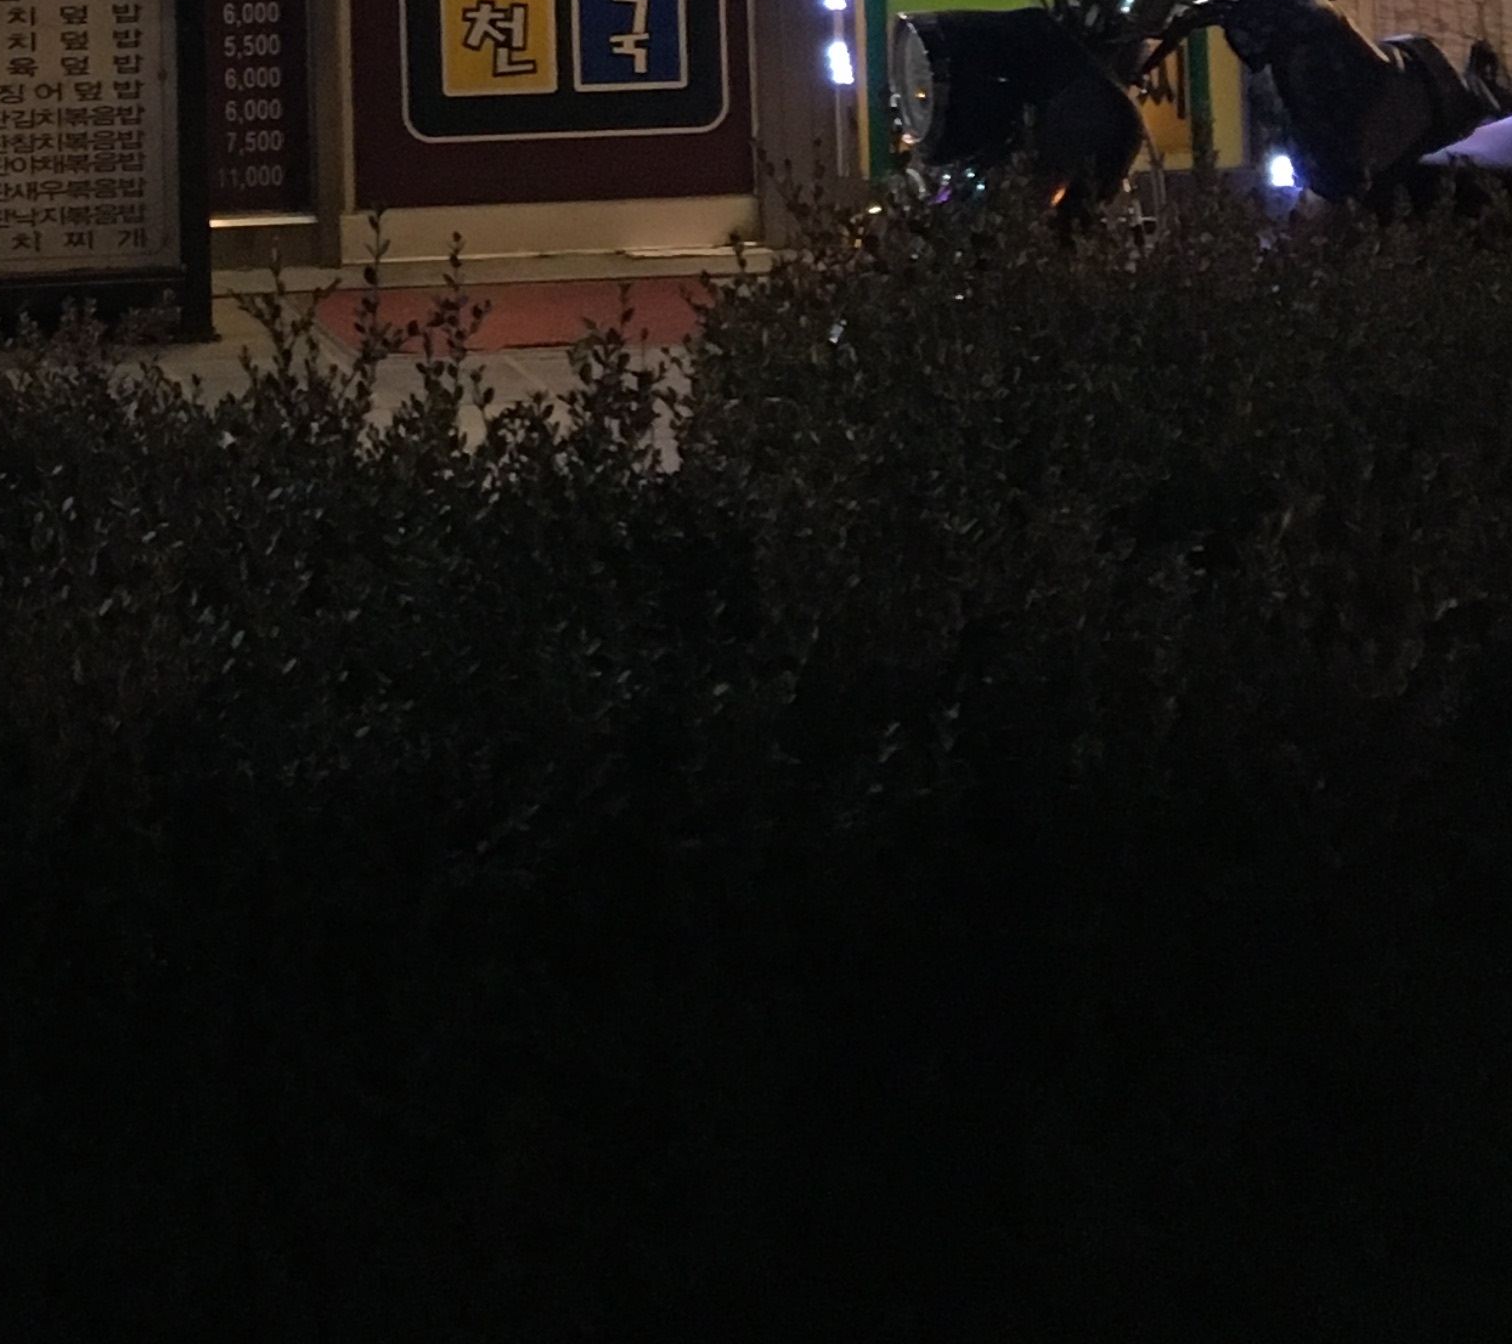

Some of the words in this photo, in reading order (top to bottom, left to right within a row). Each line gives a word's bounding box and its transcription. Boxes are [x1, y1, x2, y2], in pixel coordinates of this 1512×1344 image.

[223, 1, 281, 27] 6,000
[223, 34, 282, 59] 5,500
[224, 66, 282, 92] 6,000
[225, 99, 283, 125] 6,000
[226, 130, 284, 156] 7,500
[218, 163, 284, 190] 11,000
